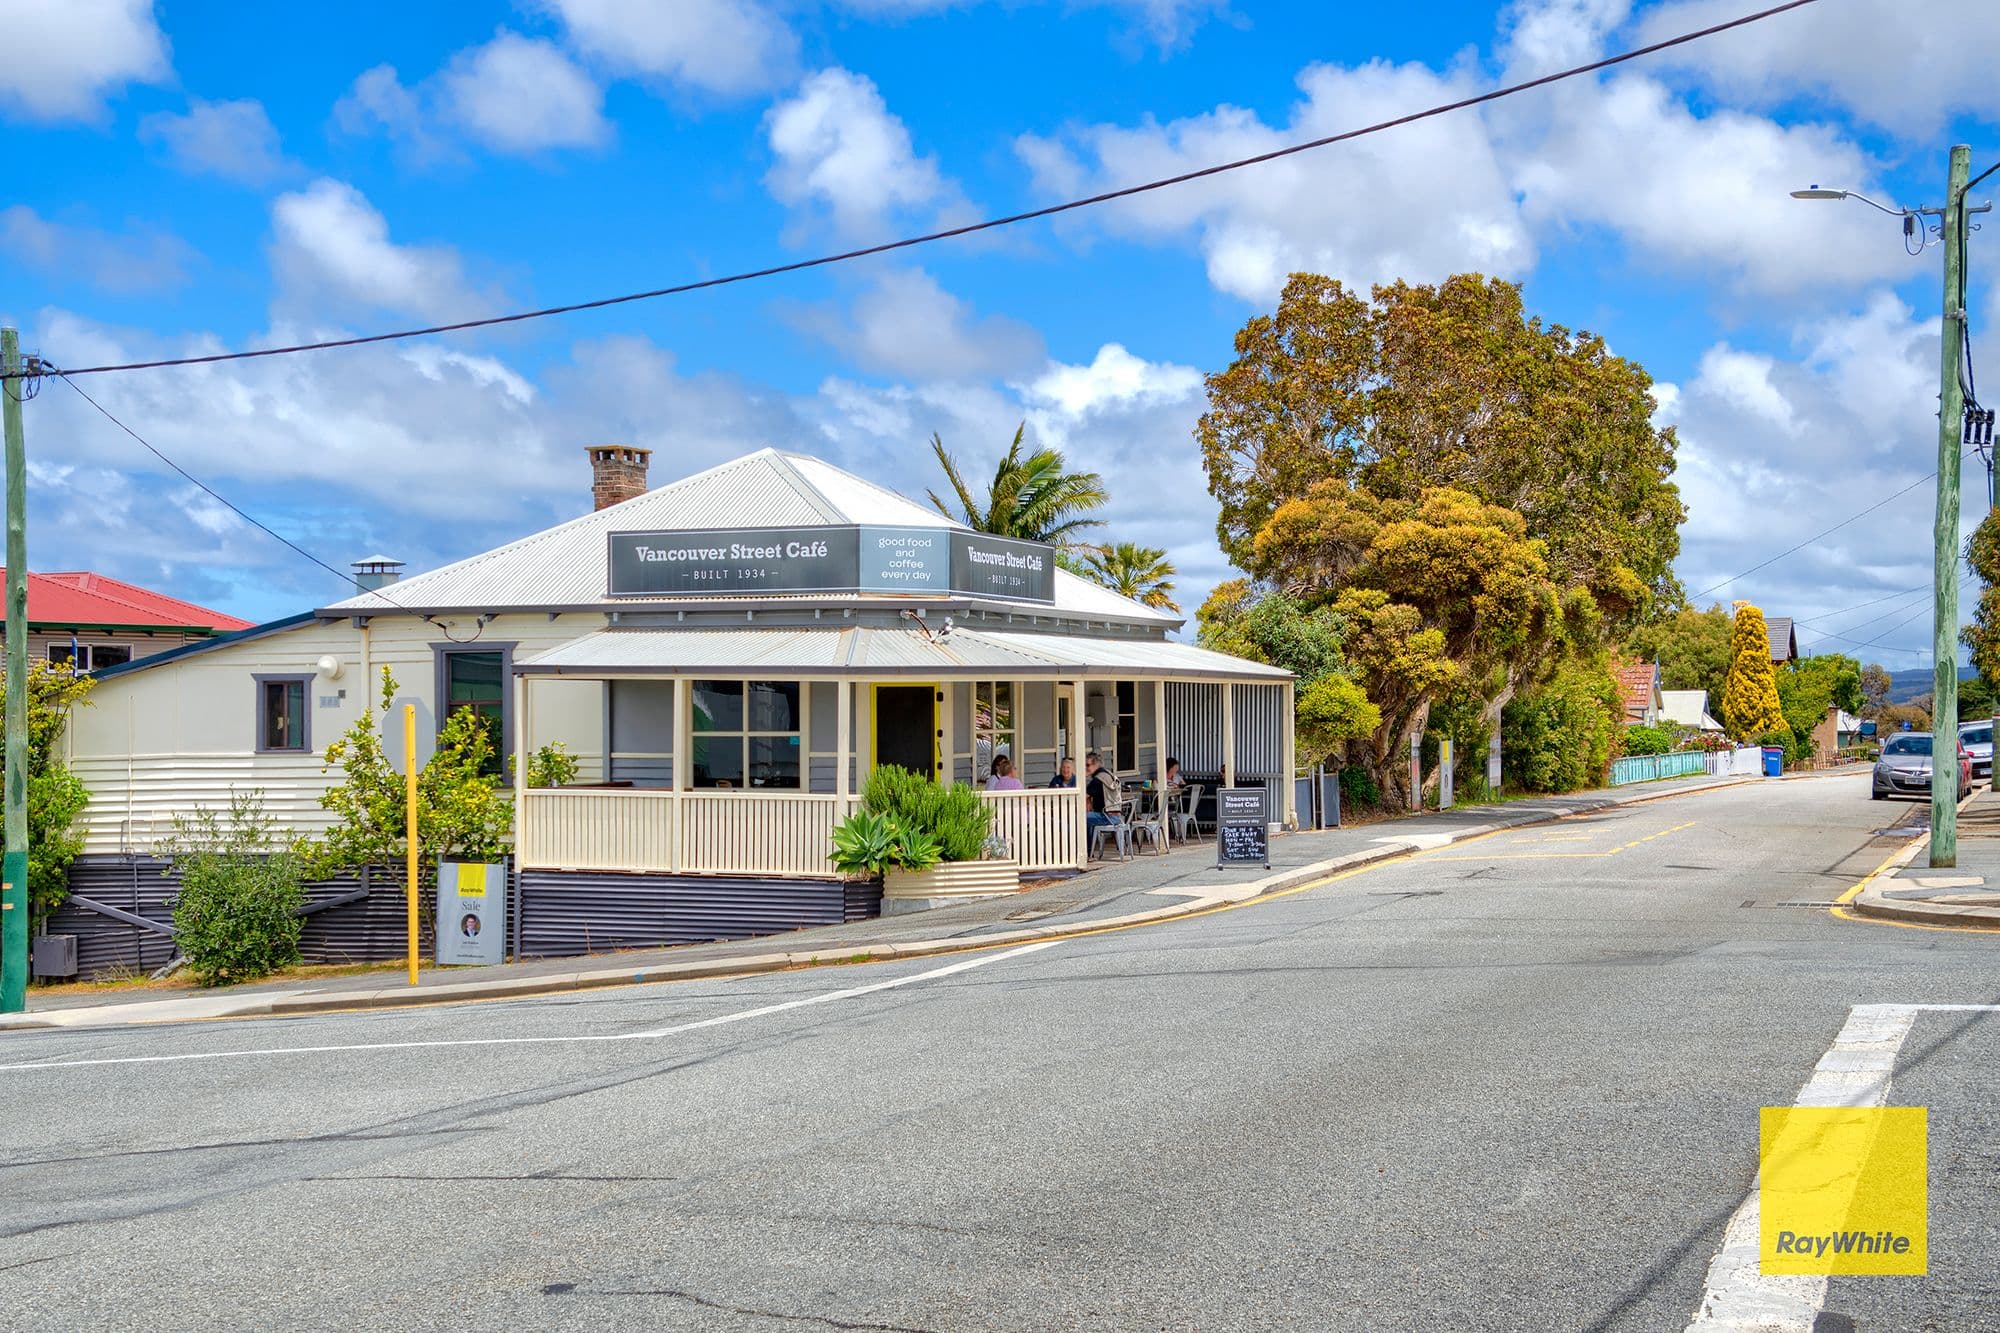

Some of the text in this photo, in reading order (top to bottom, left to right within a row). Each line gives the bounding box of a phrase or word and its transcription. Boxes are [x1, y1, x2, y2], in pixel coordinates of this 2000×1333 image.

[878, 537, 932, 548] good food
[635, 541, 828, 562] Vancouver Street Café
[895, 549, 915, 557] and
[889, 559, 924, 569] coffee
[967, 546, 1043, 571] Vancouver Street Café
[693, 568, 766, 580] BUILT 1934
[881, 570, 932, 581] every day
[992, 574, 1007, 585] BUILT
[462, 901, 481, 911] Sale
